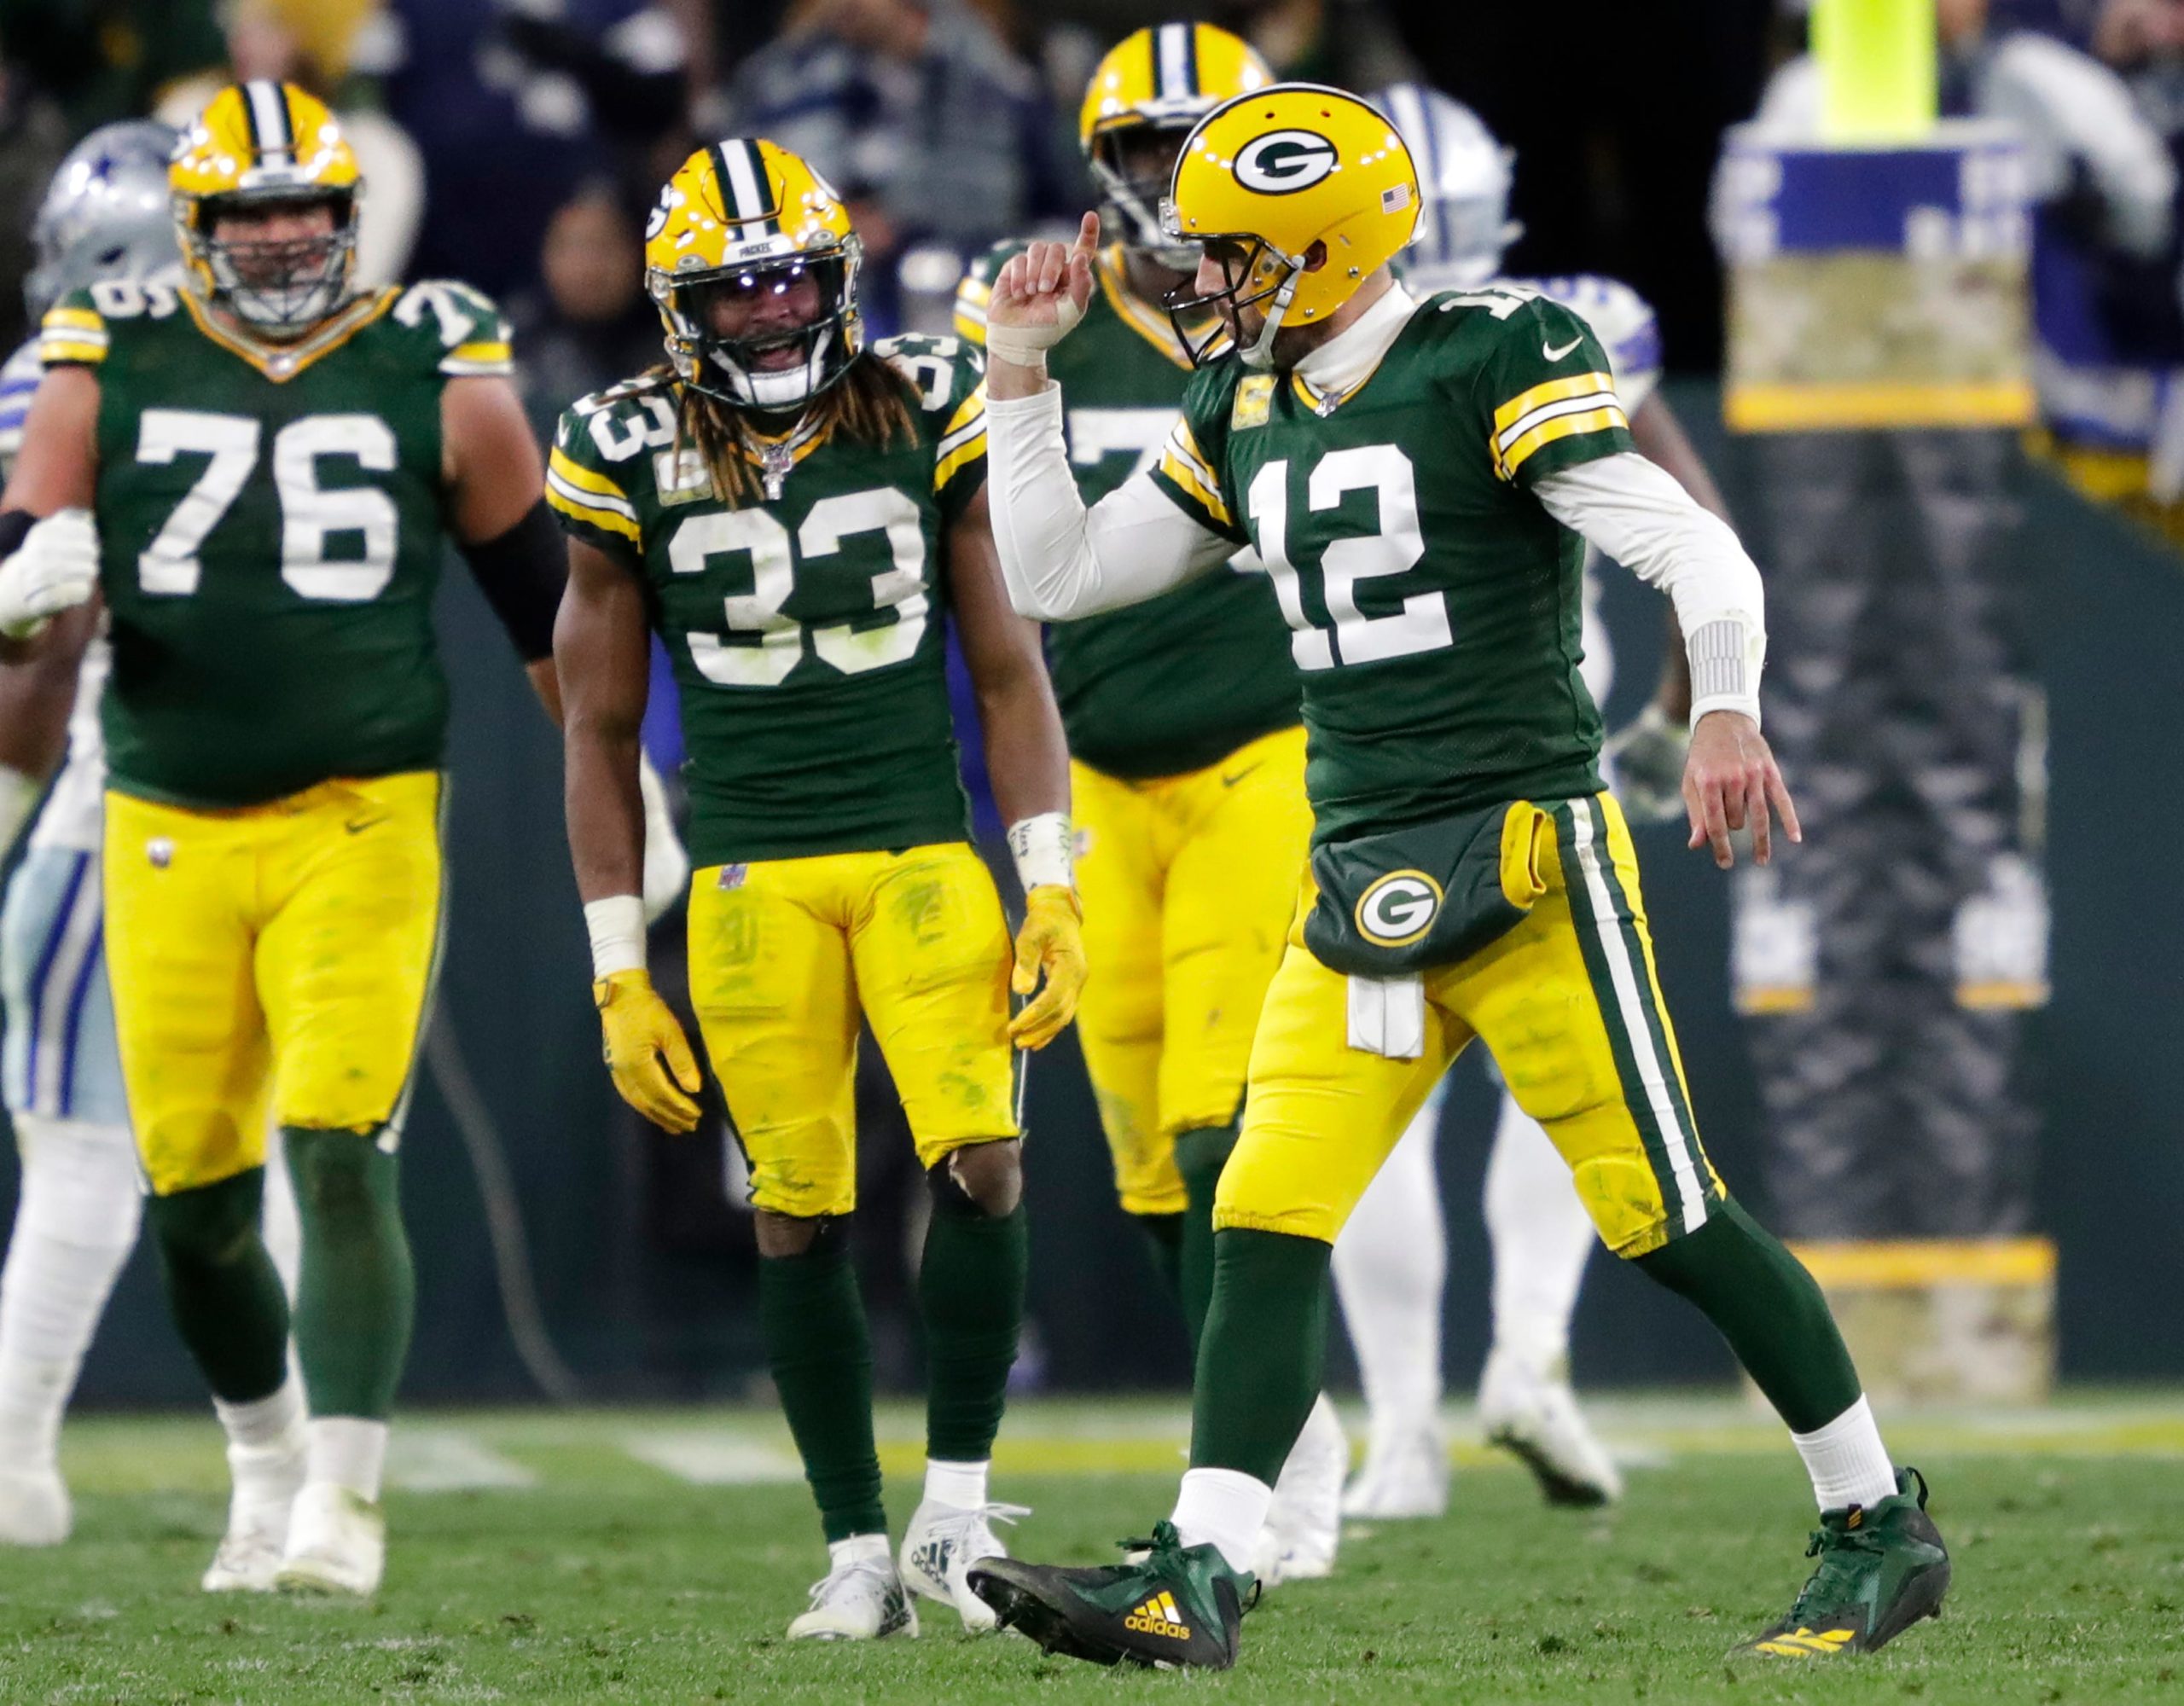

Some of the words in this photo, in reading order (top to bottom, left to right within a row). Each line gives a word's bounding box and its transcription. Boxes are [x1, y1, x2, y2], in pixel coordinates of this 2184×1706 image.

[1234, 130, 1335, 193] G
[135, 409, 399, 601] 76
[668, 486, 930, 687] 33
[1248, 443, 1454, 671] 12
[1362, 878, 1434, 937] G
[910, 1550, 952, 1595] adid
[1124, 1615, 1191, 1640] adidas
